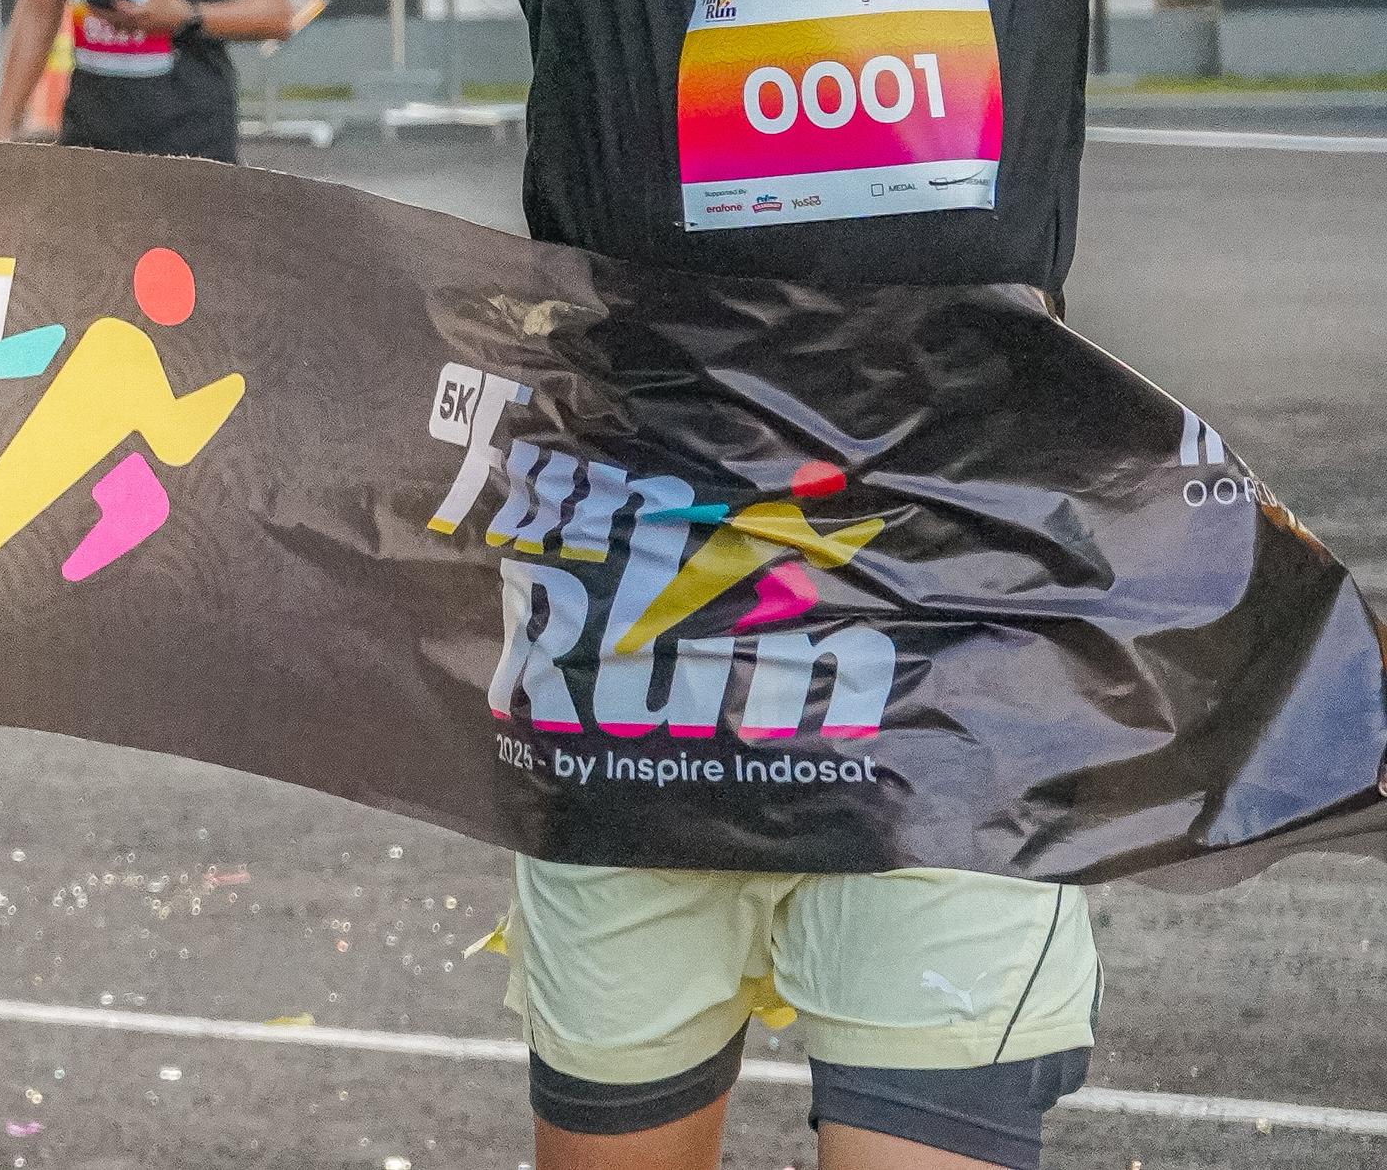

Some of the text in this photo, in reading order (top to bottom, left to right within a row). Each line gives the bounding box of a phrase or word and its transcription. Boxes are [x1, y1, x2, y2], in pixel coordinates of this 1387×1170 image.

[705, 4, 737, 19] Run
[742, 53, 946, 135] 0001
[438, 379, 477, 425] 5K
[426, 370, 697, 564] Fun
[488, 556, 899, 740] Run
[495, 732, 533, 771] 2025
[554, 748, 597, 785] by
[606, 749, 725, 787] Inspire
[735, 753, 878, 784] Indosat
